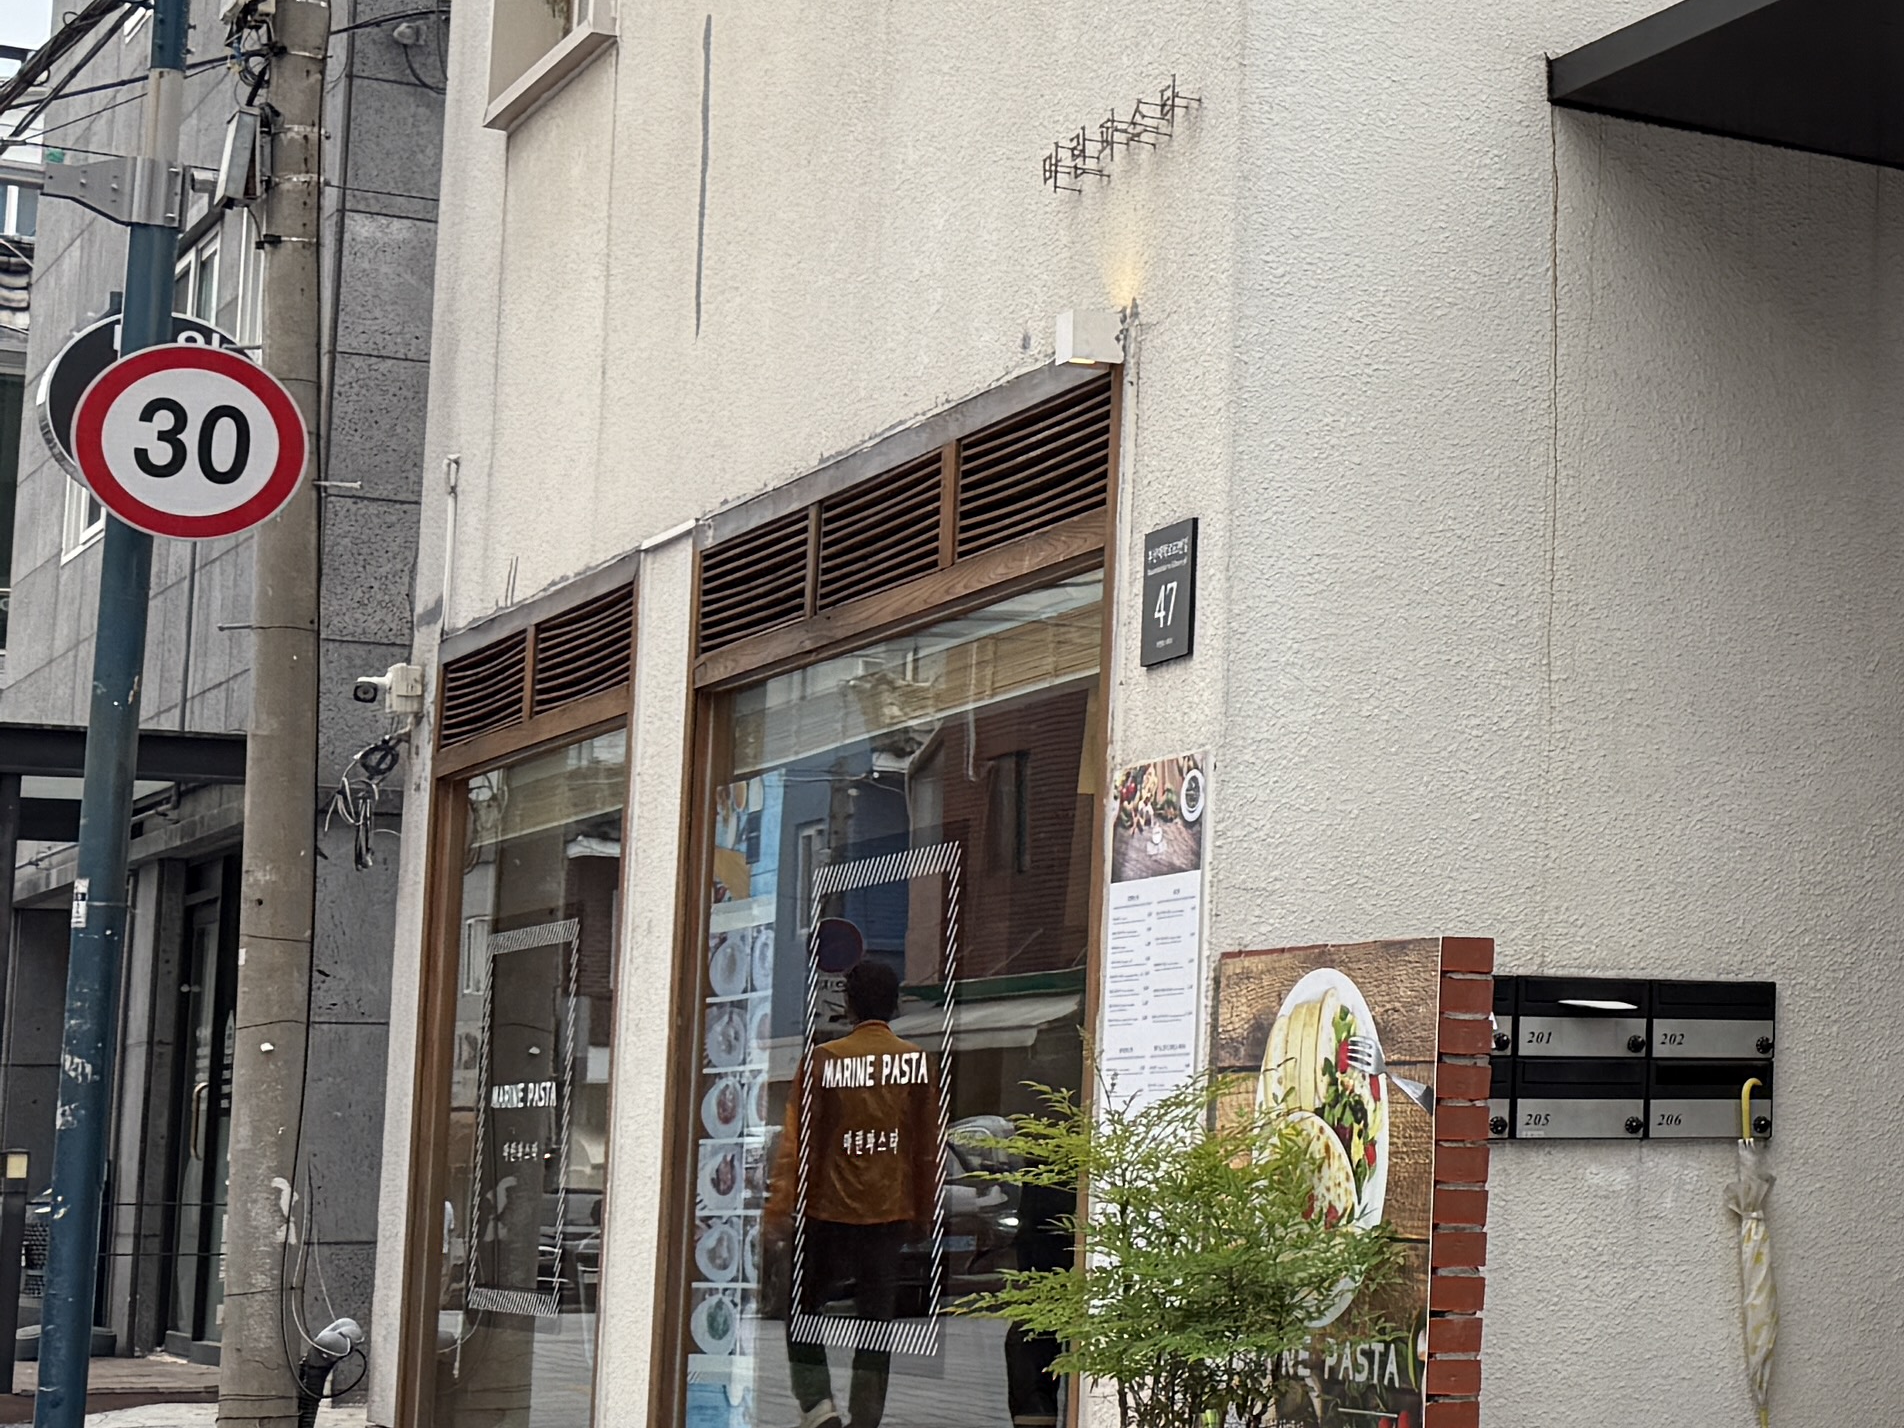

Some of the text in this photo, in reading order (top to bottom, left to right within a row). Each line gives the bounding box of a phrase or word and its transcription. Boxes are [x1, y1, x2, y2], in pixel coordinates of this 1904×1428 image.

[132, 396, 251, 485] 30
[1153, 580, 1178, 629] 47
[1526, 1030, 1553, 1045] 201
[1660, 1032, 1685, 1046] 202
[822, 1051, 929, 1089] MARINE PASTA
[490, 1081, 558, 1109] MARINE PASTA
[1524, 1112, 1551, 1127] 205
[1656, 1112, 1683, 1127] 206
[842, 1127, 900, 1156] 마린파스타
[1323, 1336, 1401, 1389] PASTA
